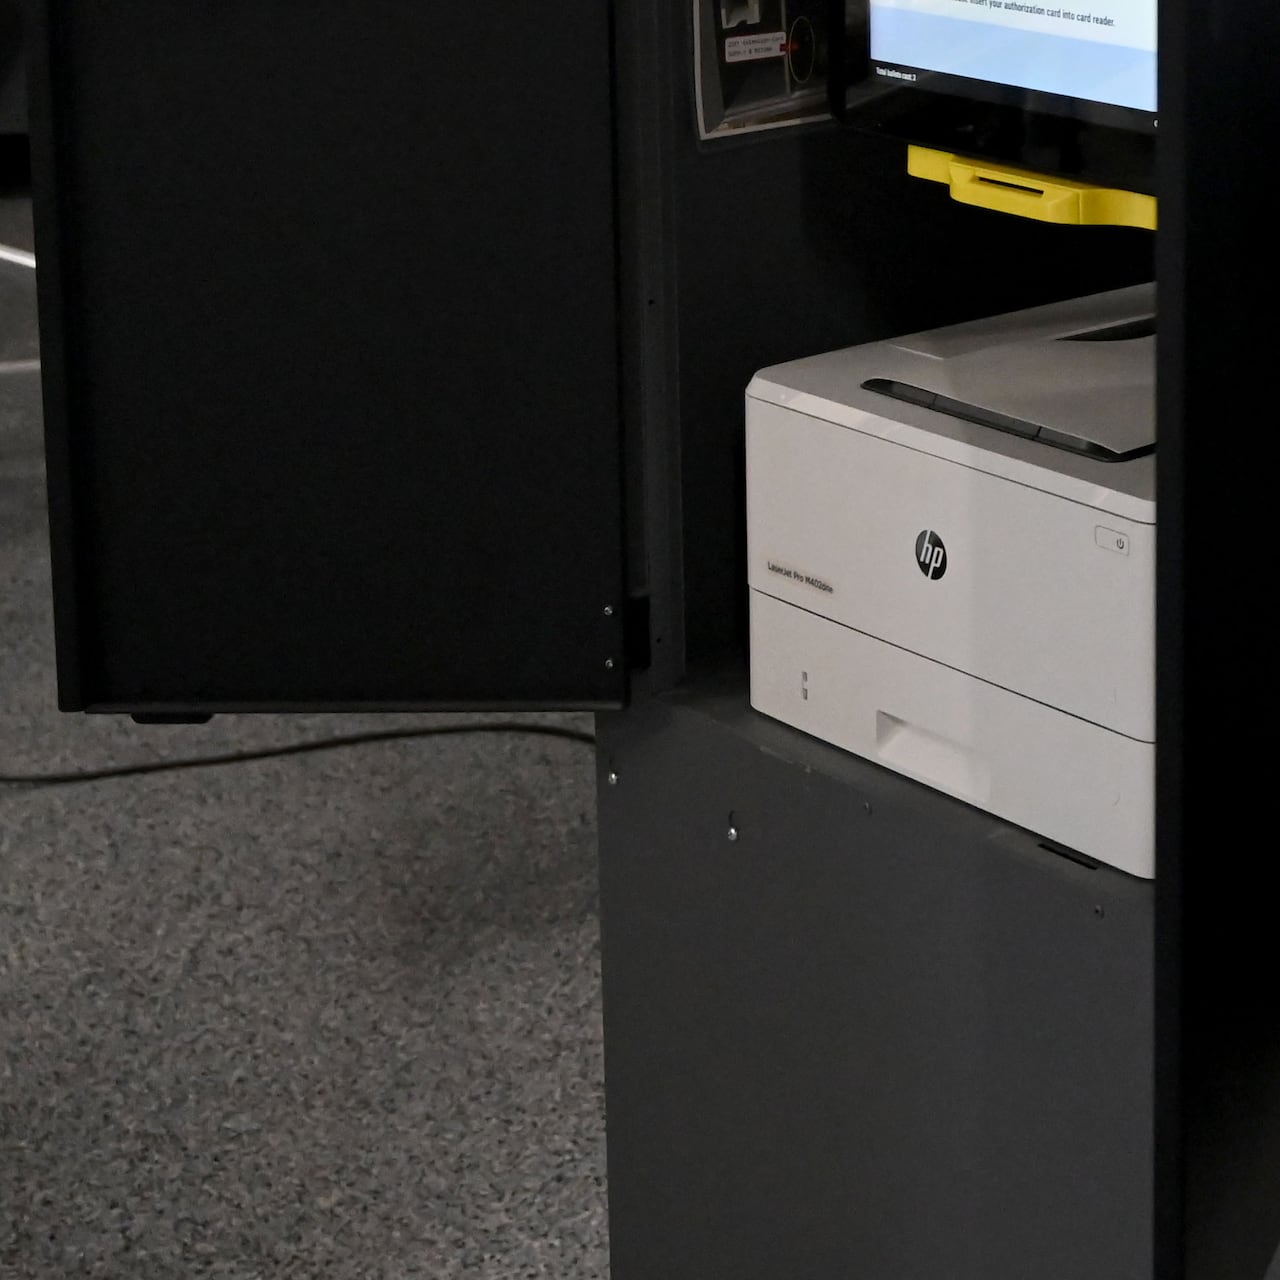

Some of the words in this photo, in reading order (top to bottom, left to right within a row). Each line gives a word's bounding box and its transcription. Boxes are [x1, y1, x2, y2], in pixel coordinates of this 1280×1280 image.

[989, 1, 1002, 10] your
[1004, 2, 1046, 16] authorization
[1046, 8, 1061, 19] card
[1062, 9, 1076, 21] into
[1076, 13, 1092, 24] card
[1092, 15, 1116, 27] reader.
[918, 530, 945, 581] hp
[768, 561, 792, 578] LaserJet
[793, 571, 804, 583] Pro
